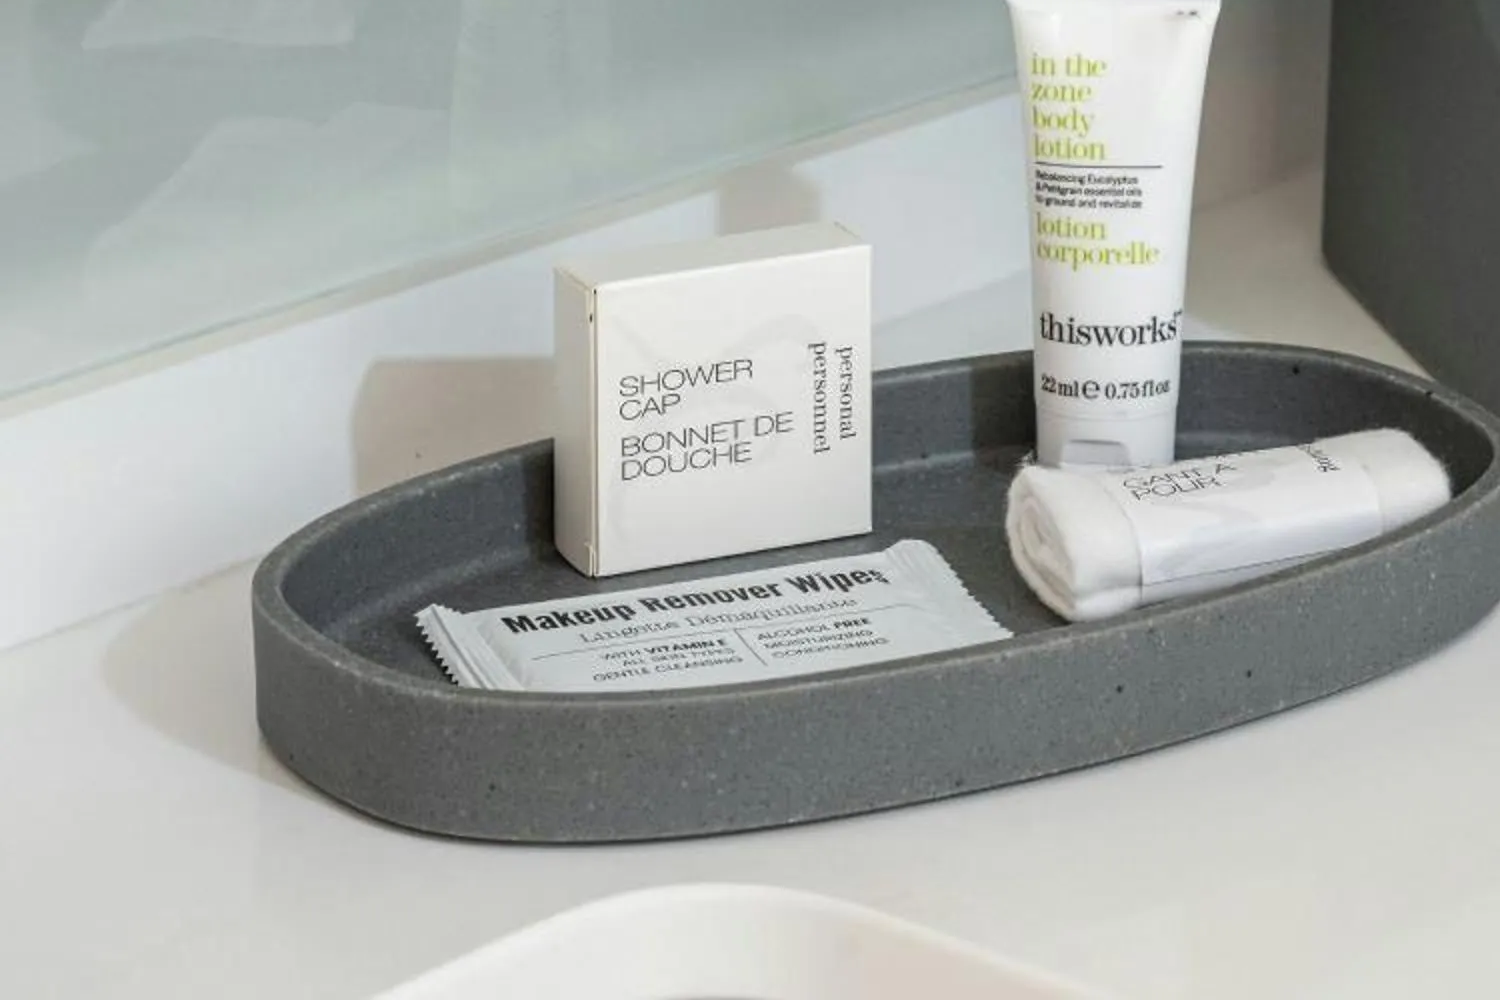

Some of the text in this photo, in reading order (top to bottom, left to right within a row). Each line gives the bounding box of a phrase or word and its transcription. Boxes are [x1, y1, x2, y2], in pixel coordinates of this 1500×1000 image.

[1030, 53, 1107, 78] in the
[1031, 83, 1092, 102] zone
[1033, 105, 1093, 137] body
[1034, 134, 1106, 161] lotion
[1084, 187, 1125, 197] essential
[1087, 173, 1139, 186] Eucalyptus
[1078, 198, 1097, 209] and
[1036, 212, 1106, 240] lotion
[1037, 241, 1161, 272] corporelle
[620, 359, 753, 398] SHOWER
[619, 393, 681, 421] CAP
[807, 341, 831, 455] personnel
[835, 346, 857, 440] personal
[621, 411, 795, 457] BONNET DE
[621, 441, 752, 481] DOUCHE
[501, 568, 891, 634] Makeup Remover Wipes
[833, 616, 871, 630] FREE
[643, 639, 715, 655] VITAMIN
[593, 665, 651, 683] GENTLE
